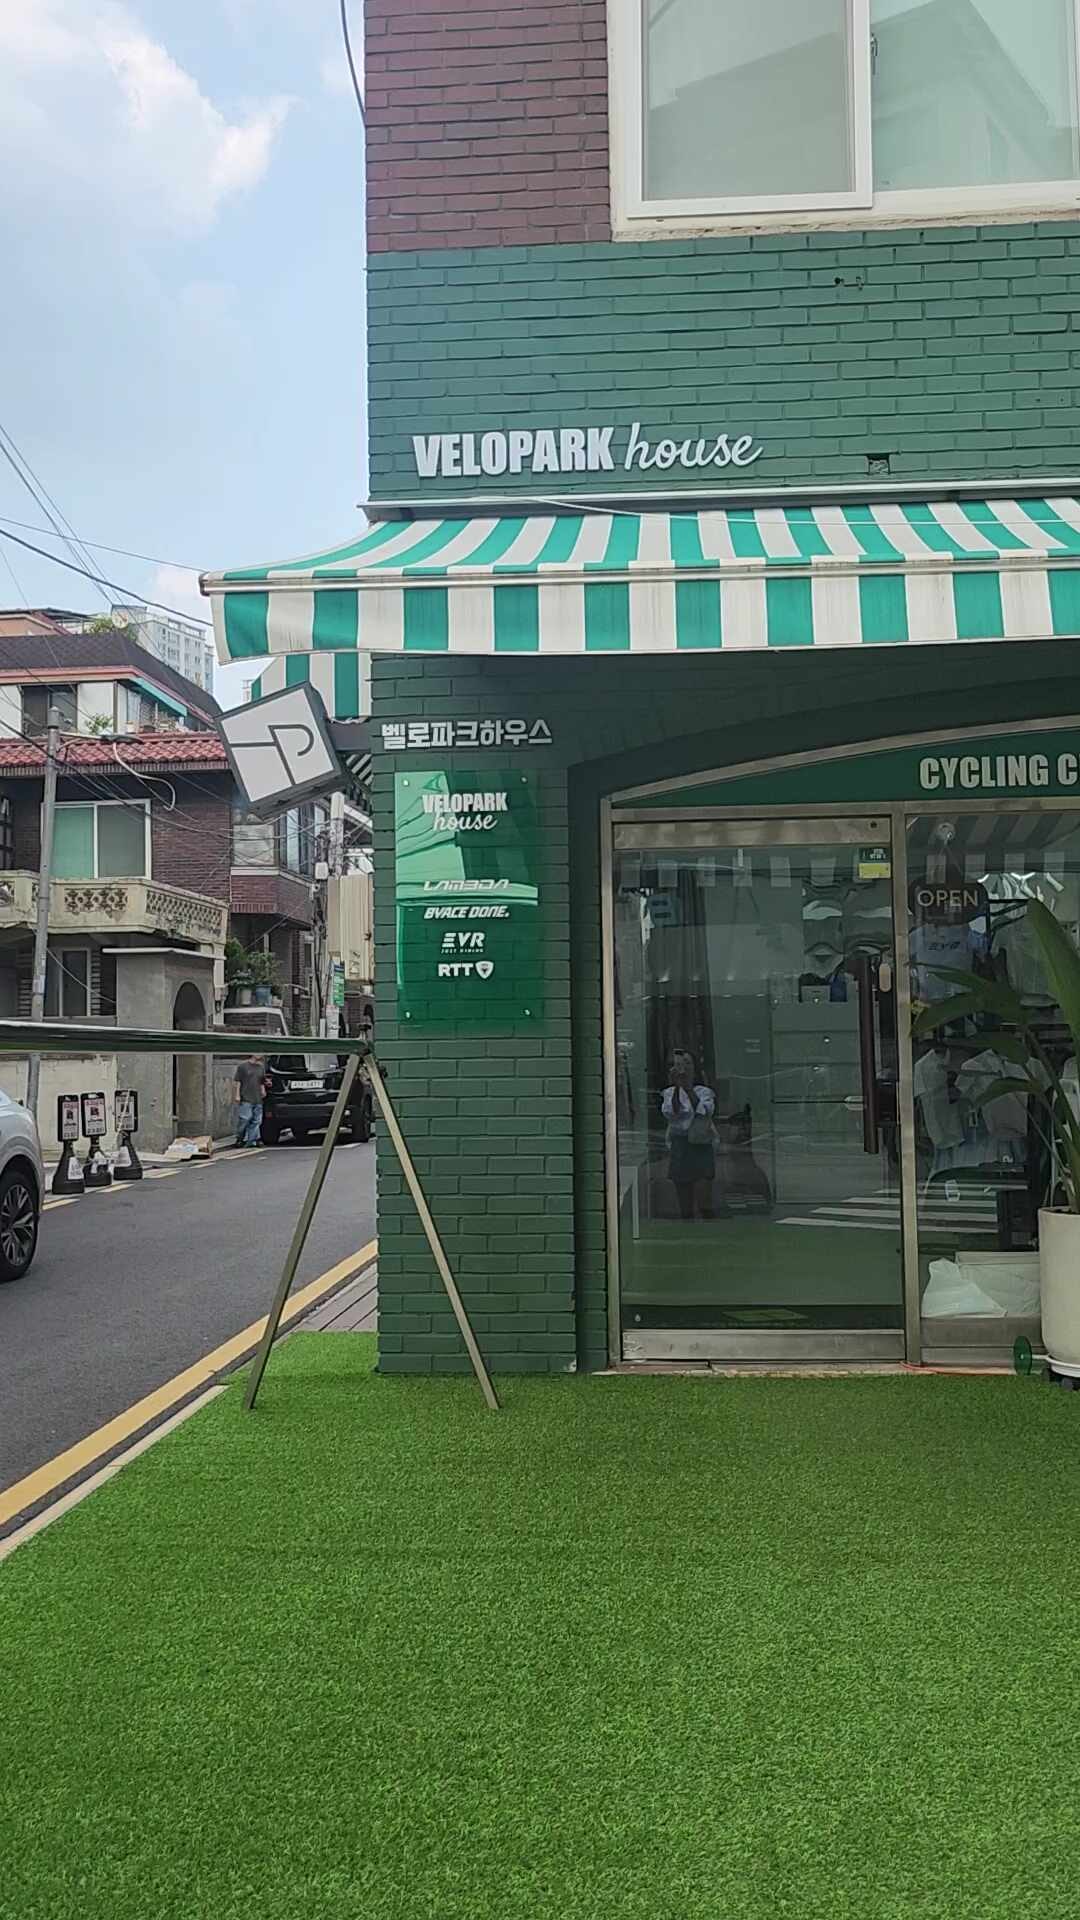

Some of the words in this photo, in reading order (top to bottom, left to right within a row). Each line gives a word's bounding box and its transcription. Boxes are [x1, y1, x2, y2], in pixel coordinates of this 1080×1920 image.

[412, 427, 615, 478] VELOPARK
[624, 422, 763, 470] house
[381, 719, 552, 750] 벨로파크하우스
[919, 755, 1049, 789] CYCLING
[422, 792, 508, 813] VELOPARK
[432, 813, 498, 832] house
[917, 890, 978, 907] OPEN
[441, 932, 485, 948] EVR
[438, 963, 474, 977] RTT
